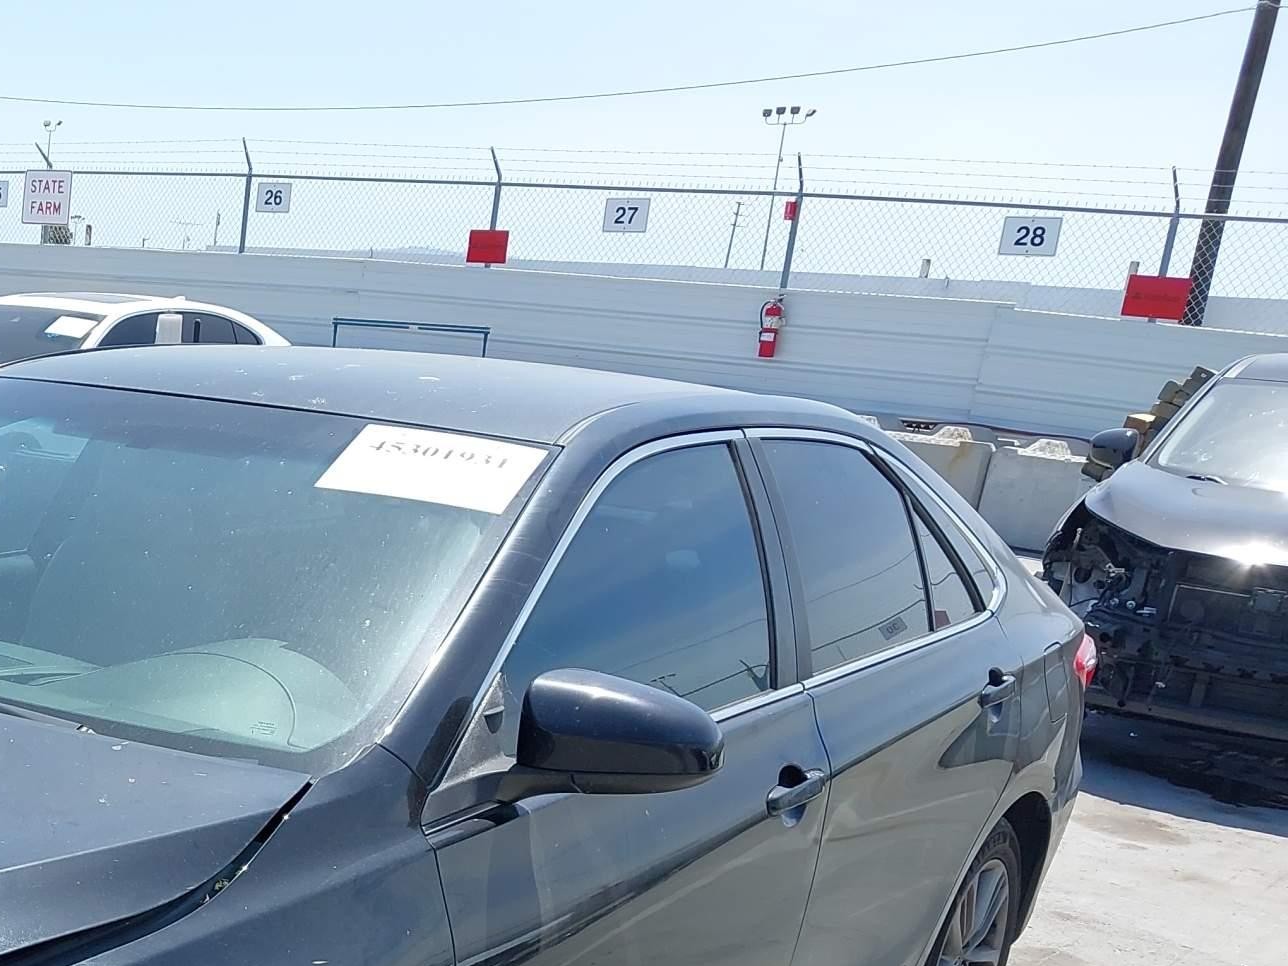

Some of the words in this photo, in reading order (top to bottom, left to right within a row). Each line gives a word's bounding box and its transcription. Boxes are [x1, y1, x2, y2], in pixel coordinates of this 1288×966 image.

[30, 179, 65, 194] STATE
[264, 190, 282, 206] 26
[30, 201, 61, 216] FARM
[614, 206, 639, 225] 27
[1014, 226, 1046, 247] 28
